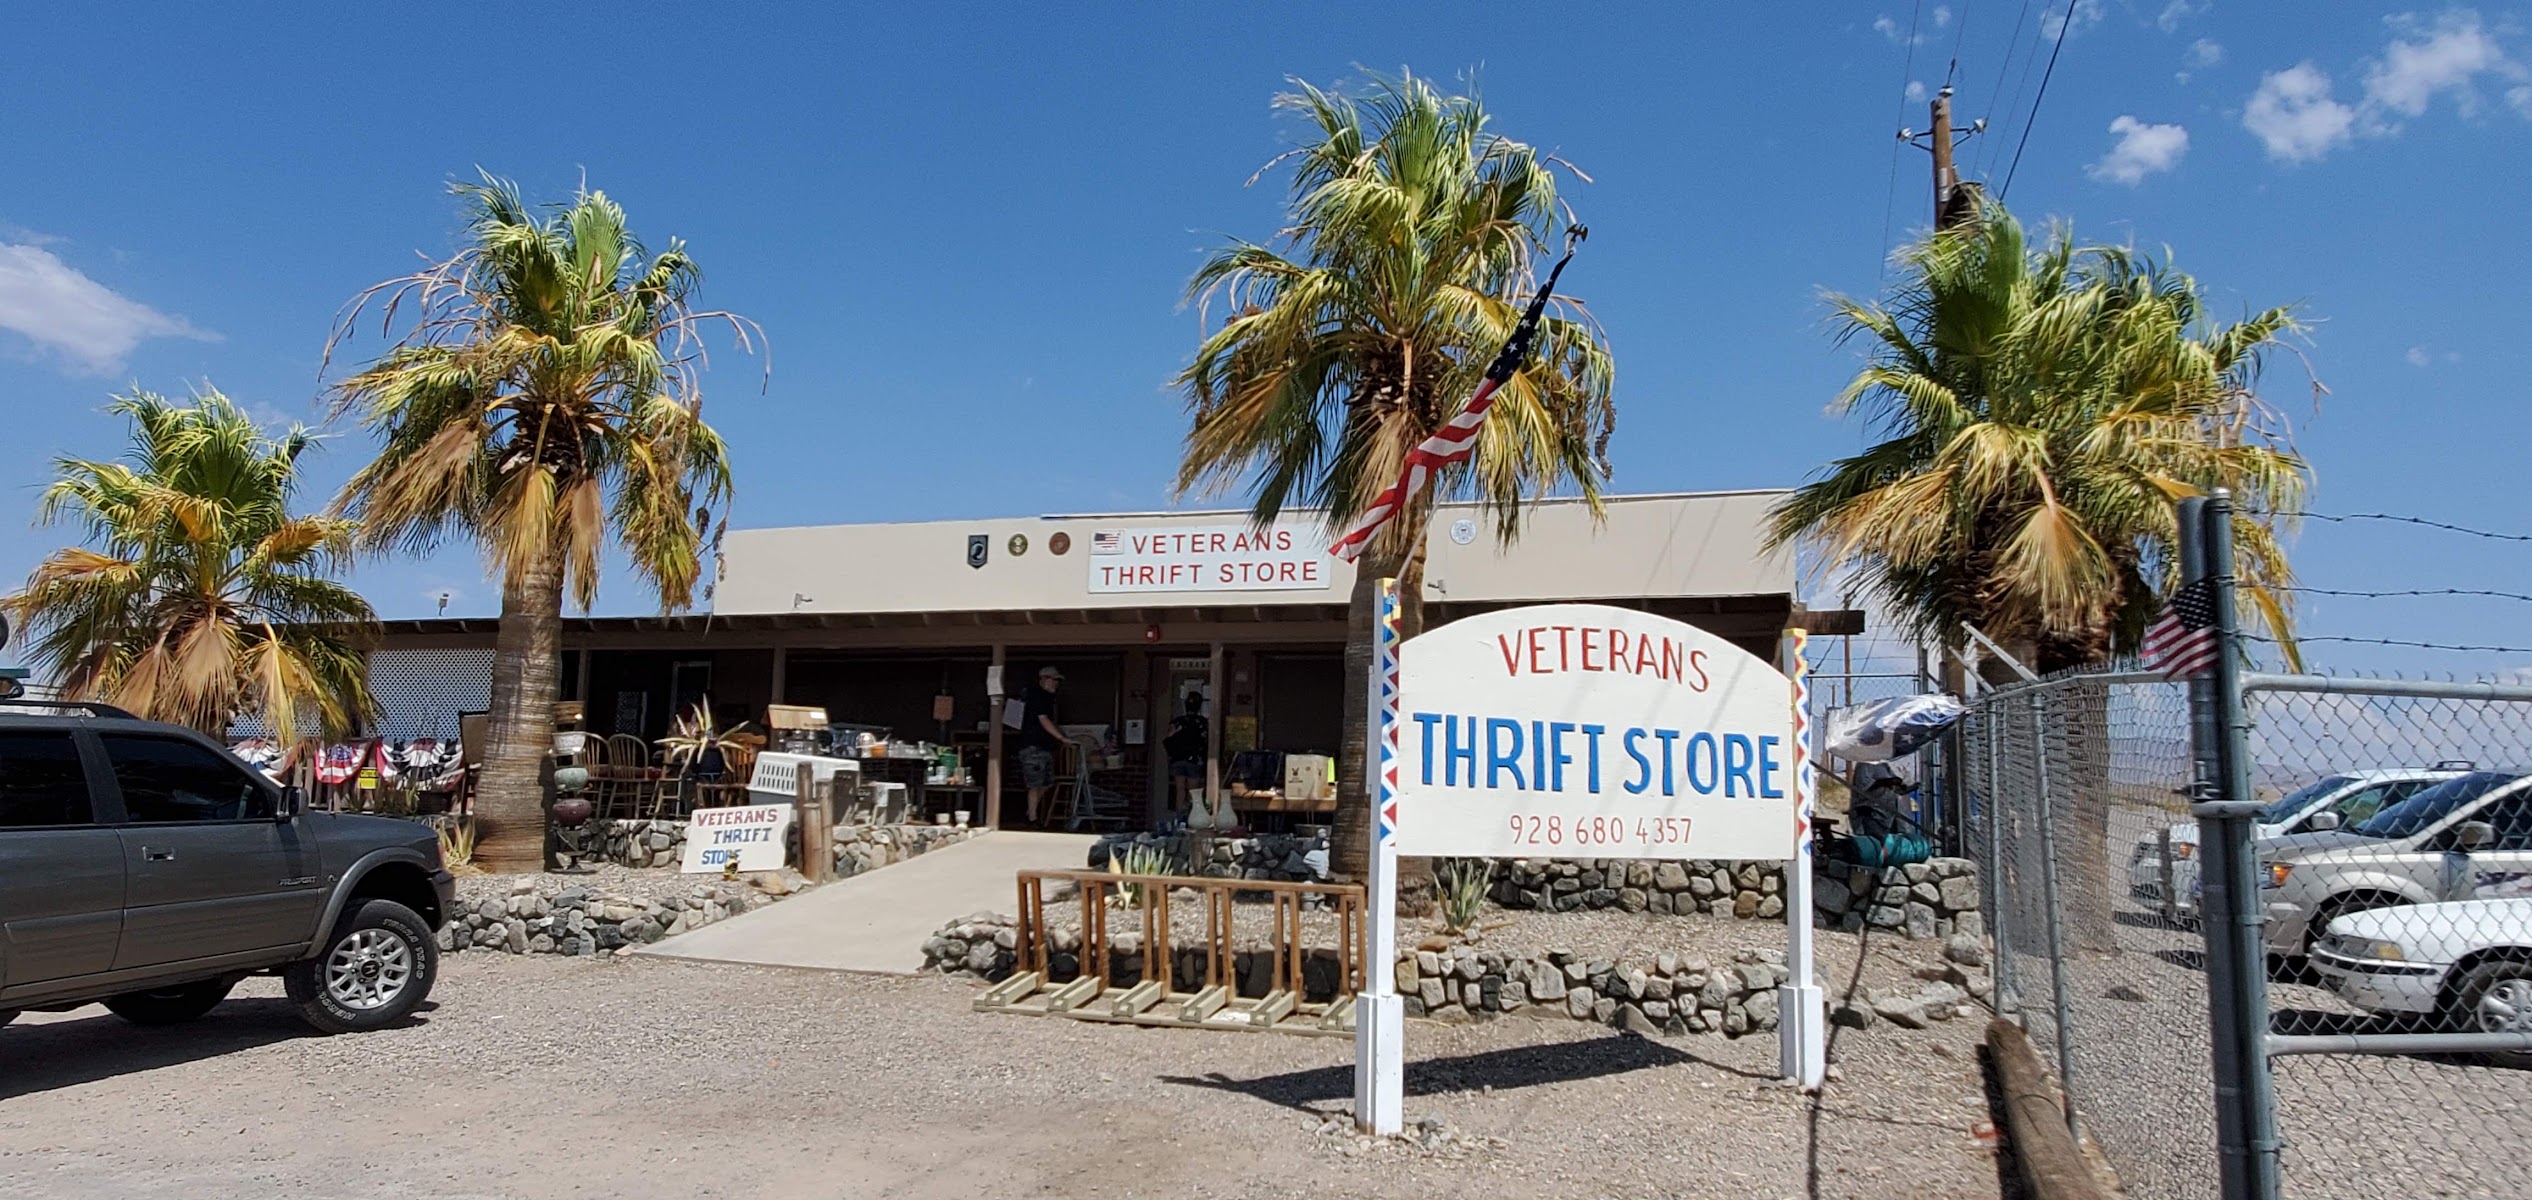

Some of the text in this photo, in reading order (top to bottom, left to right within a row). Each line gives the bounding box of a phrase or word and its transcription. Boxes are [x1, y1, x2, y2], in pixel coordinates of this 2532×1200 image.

[1132, 531, 1292, 555] VETERANS
[1101, 561, 1318, 586] THRIFT STORE
[1498, 626, 1710, 693] VETERANS
[1413, 712, 1784, 799] THRIFT STORE
[713, 827, 773, 845] THRIFT
[1510, 815, 1692, 845] 928 680 4357
